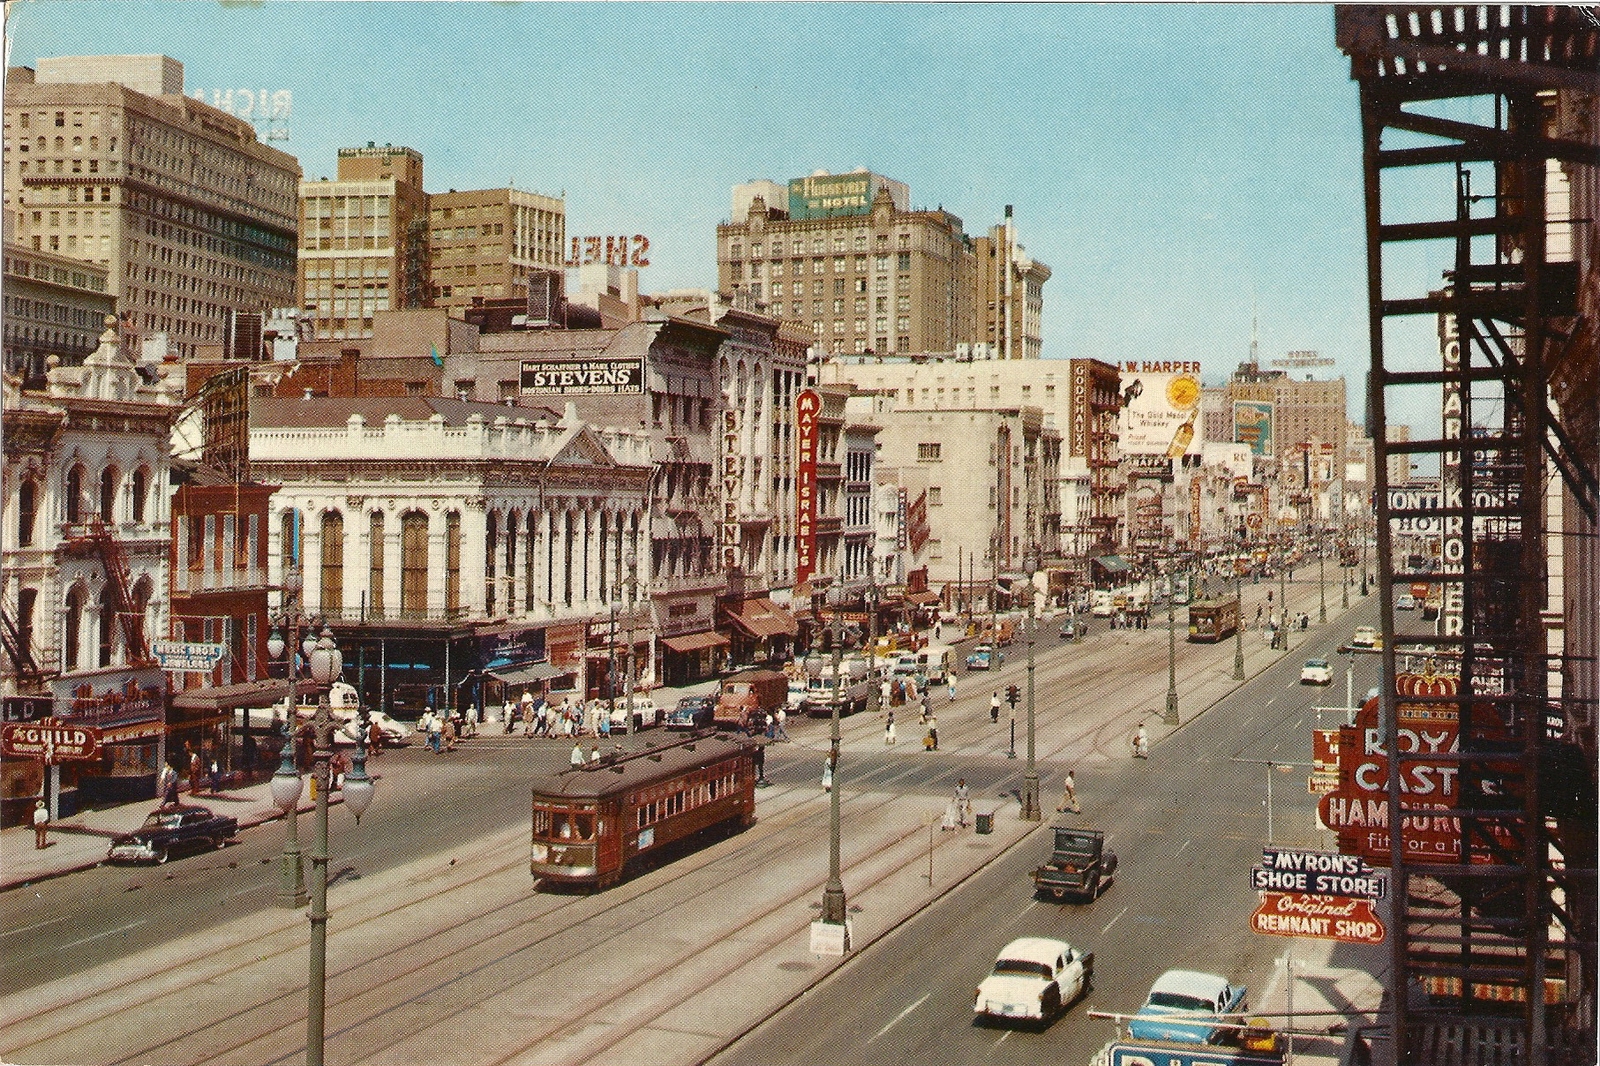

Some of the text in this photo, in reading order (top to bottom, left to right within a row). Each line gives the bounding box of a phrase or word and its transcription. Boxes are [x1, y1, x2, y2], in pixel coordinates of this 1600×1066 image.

[822, 195, 867, 208] HOTEL
[534, 369, 631, 386] STEVENS
[1142, 361, 1201, 373] HARPER
[724, 411, 738, 567] STEVENS
[800, 397, 813, 566] MAYER ISRAEL'S
[27, 729, 87, 745] GUILD
[1365, 728, 1486, 757] ROY
[1367, 832, 1391, 848] fit
[1401, 834, 1428, 850] or
[1435, 840, 1446, 850] a
[1275, 851, 1359, 875] MYRON'S
[1256, 870, 1379, 897] SHOE STORE
[1277, 895, 1357, 917] Original
[1257, 913, 1377, 938] REMNANT SHOP
